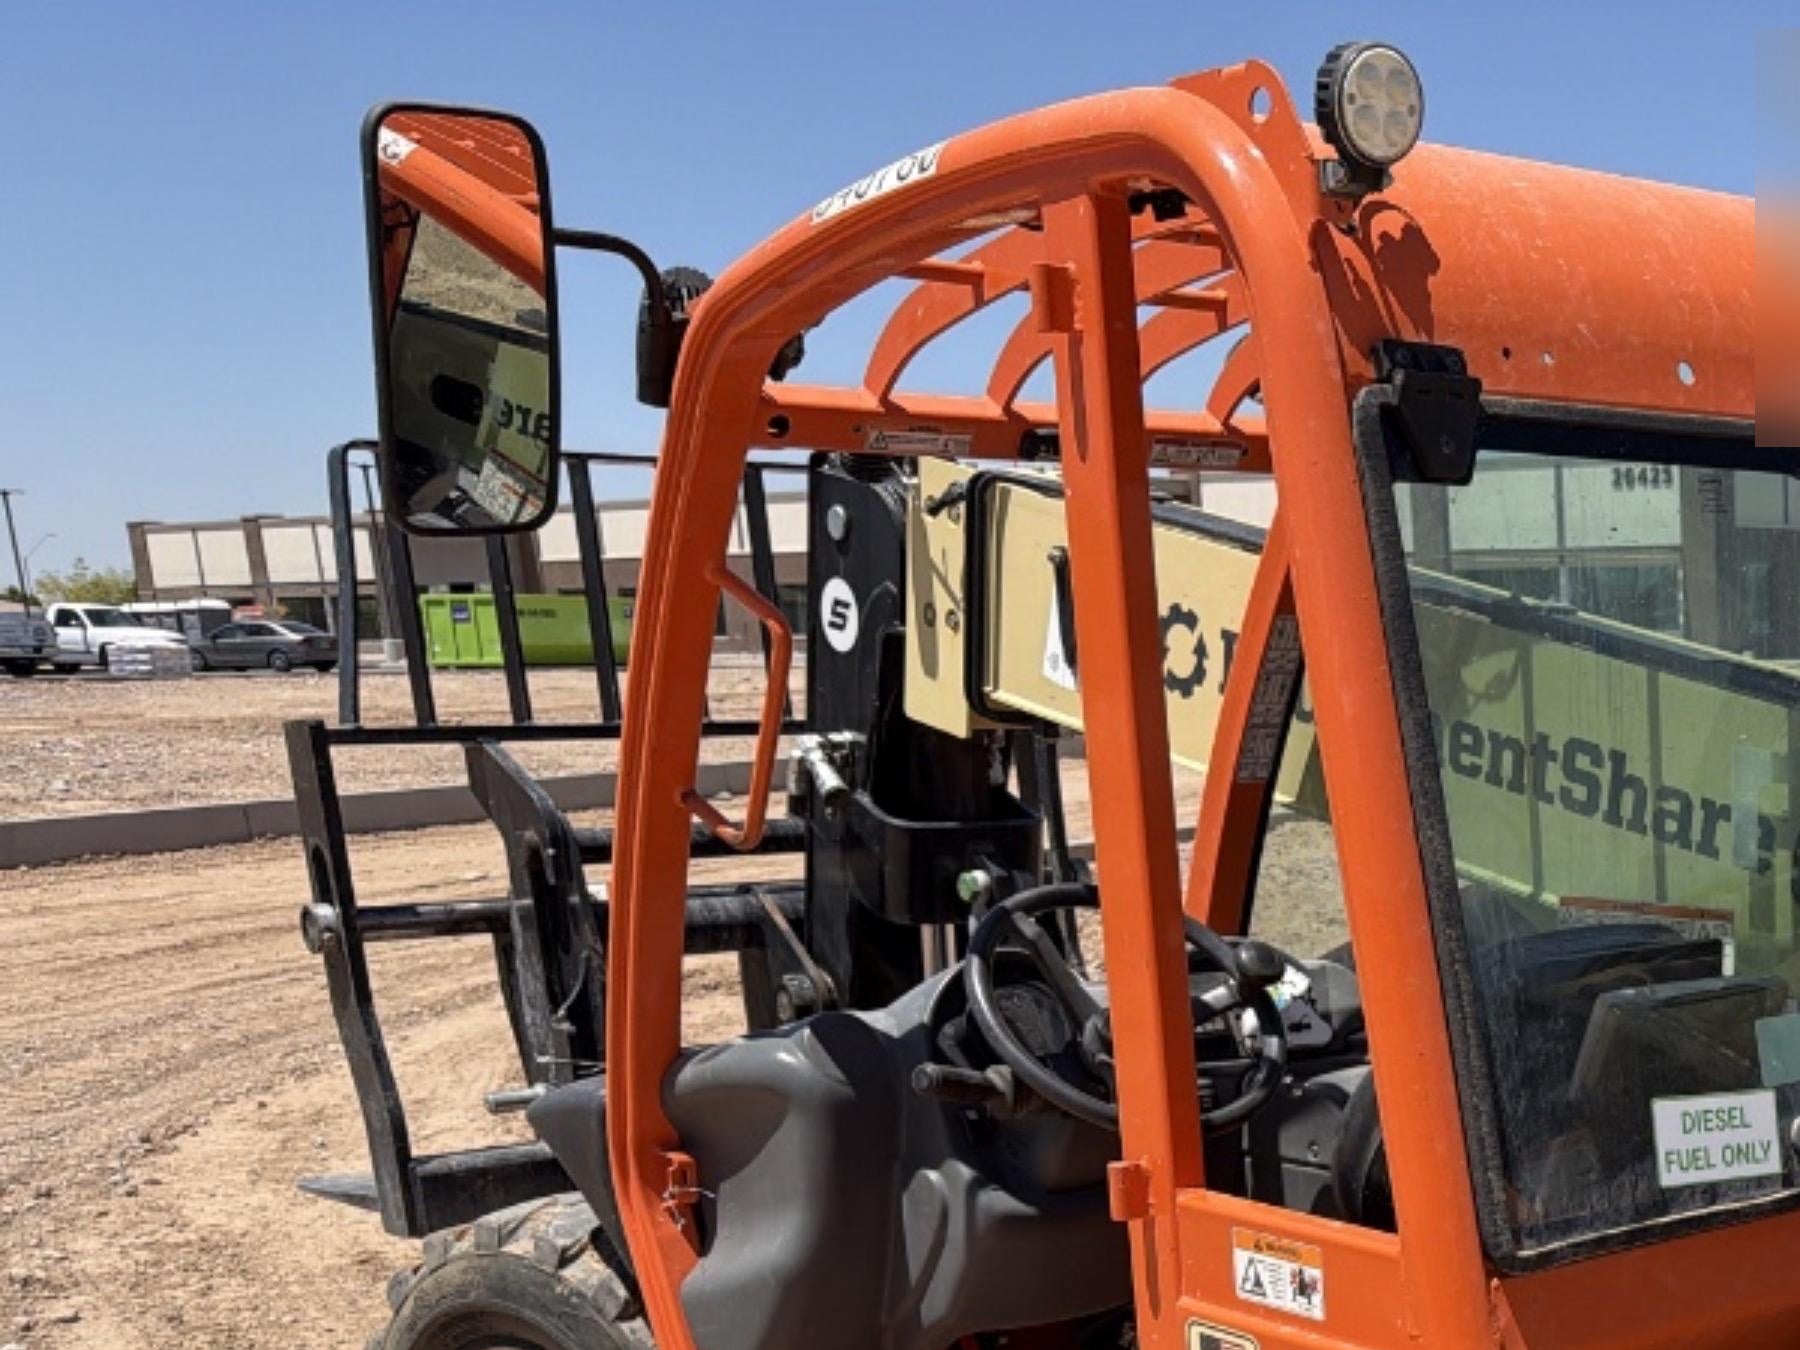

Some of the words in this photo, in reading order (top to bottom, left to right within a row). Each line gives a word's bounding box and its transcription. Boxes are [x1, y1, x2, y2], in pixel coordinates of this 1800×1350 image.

[1681, 1105, 1753, 1135] DIESEL
[1664, 1146, 1717, 1174] FUEL
[1721, 1139, 1772, 1168] ONLY
